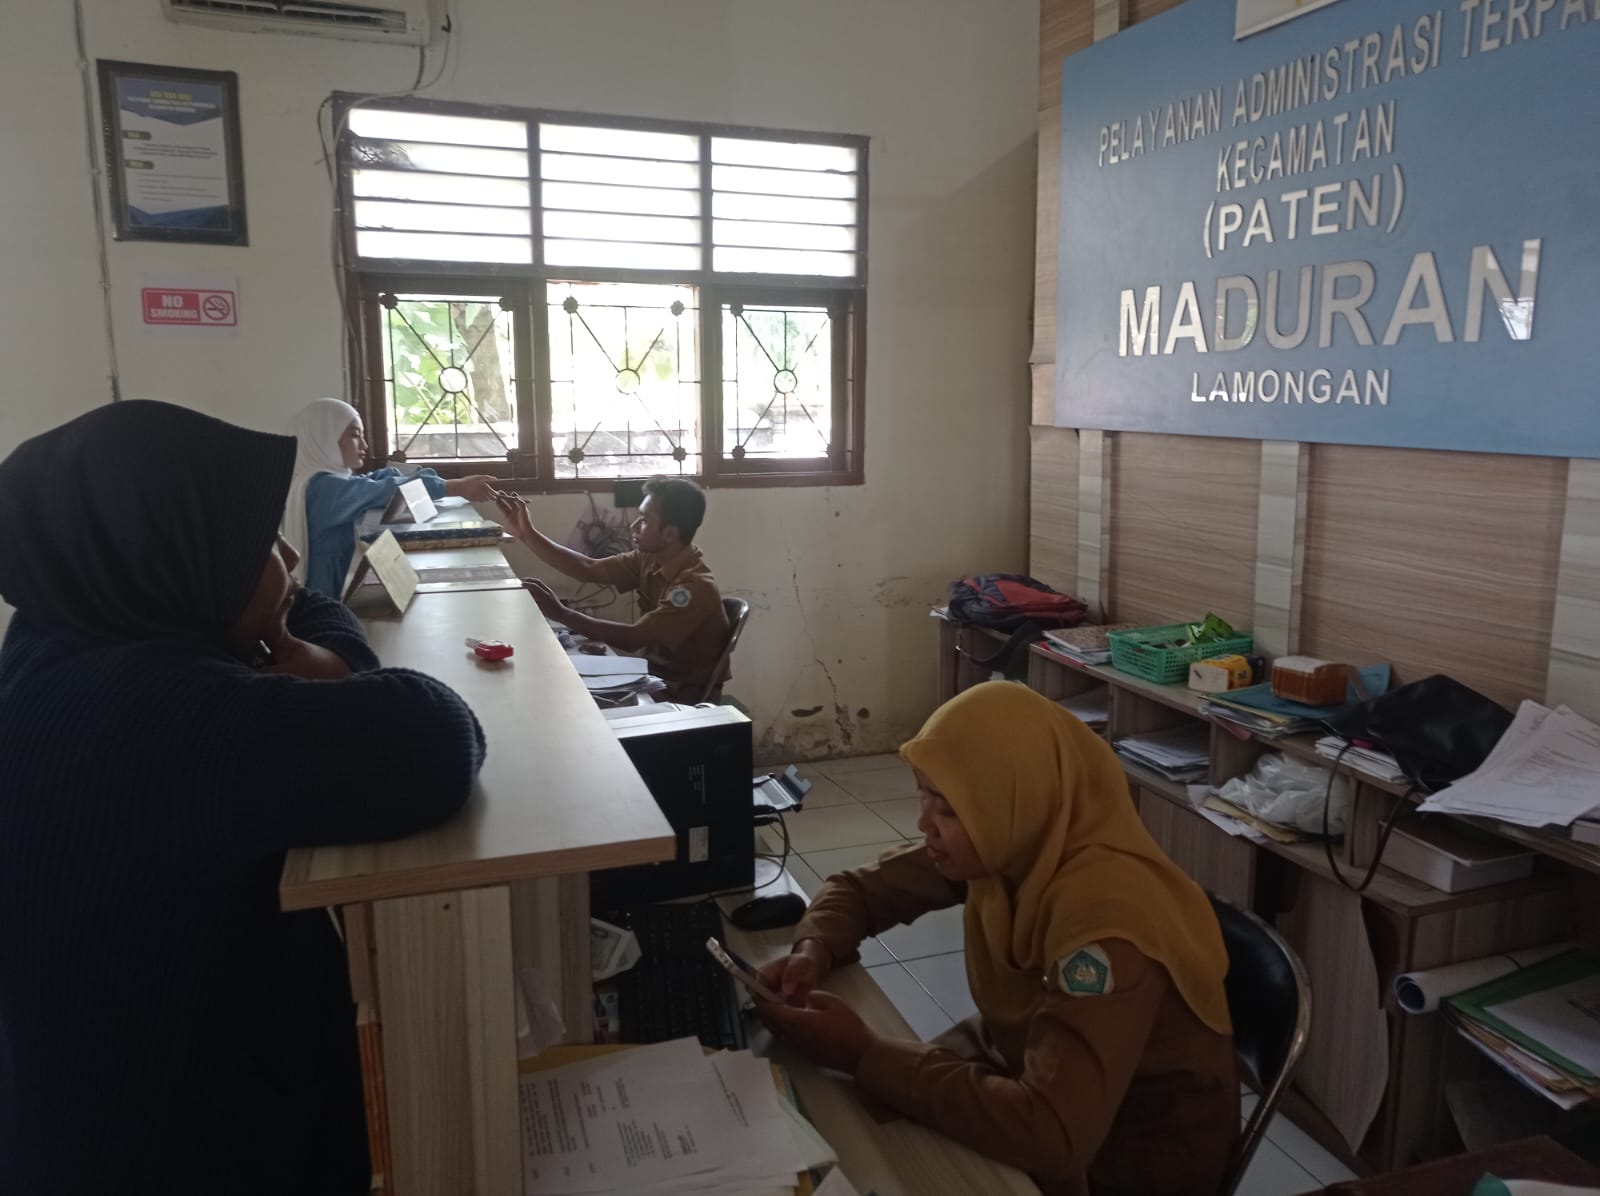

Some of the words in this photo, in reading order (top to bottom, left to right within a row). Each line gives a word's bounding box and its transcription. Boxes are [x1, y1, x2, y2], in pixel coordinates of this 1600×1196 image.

[1099, 86, 1222, 167] PELAYANAN
[1232, 11, 1441, 127] ADMINISTRASI
[1461, 0, 1600, 58] TERPA
[1216, 101, 1396, 192] KECAMATAN
[1203, 165, 1405, 258] (PATEN)
[150, 308, 198, 319] SMOKING
[161, 295, 183, 307] NO
[1119, 238, 1542, 357] MADURAN
[1191, 368, 1389, 405] LAMONGAN
